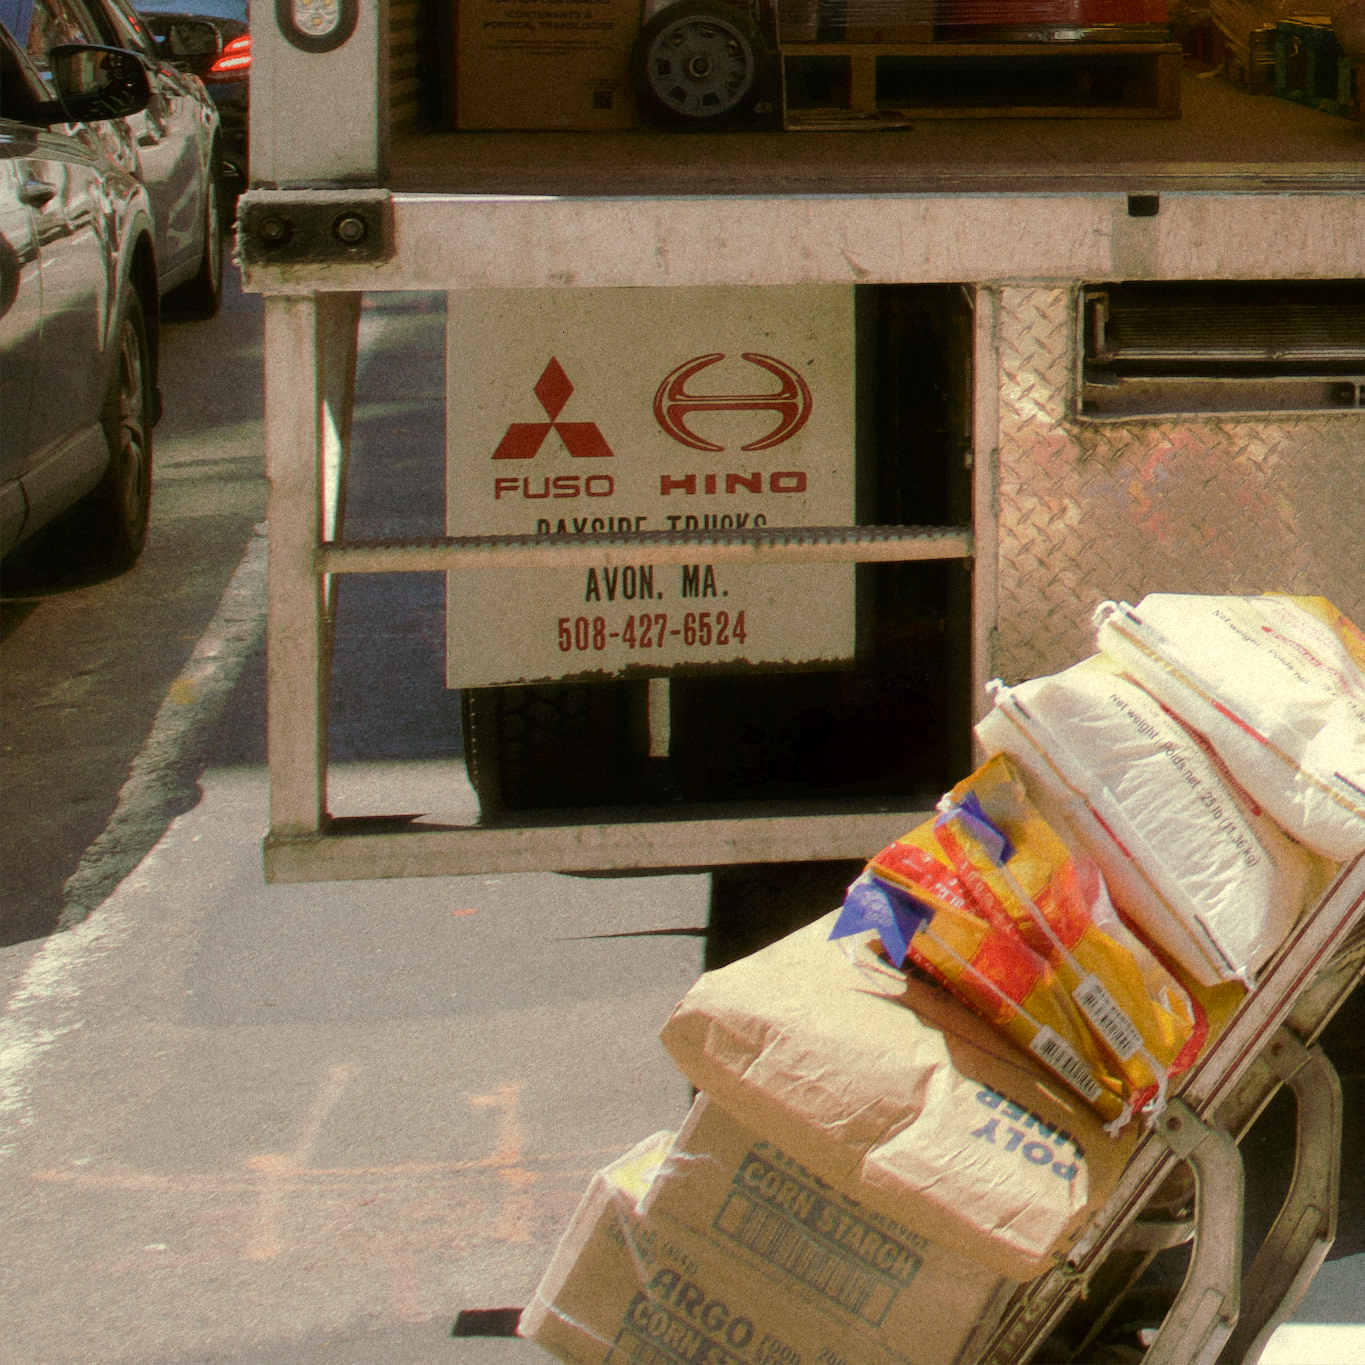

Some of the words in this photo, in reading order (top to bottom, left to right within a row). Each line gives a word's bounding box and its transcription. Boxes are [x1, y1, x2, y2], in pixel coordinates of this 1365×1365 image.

[495, 475, 615, 500] FUSO
[660, 471, 808, 496] HINO
[681, 564, 730, 599] MA.
[558, 610, 748, 653] 508-427-6524
[969, 1117, 1079, 1182] POLY
[976, 1082, 1086, 1161] LINER
[743, 1160, 817, 1216] CORN
[815, 1205, 919, 1283] STARCH
[629, 1303, 698, 1360] CORN
[649, 1268, 755, 1349] ARGO
